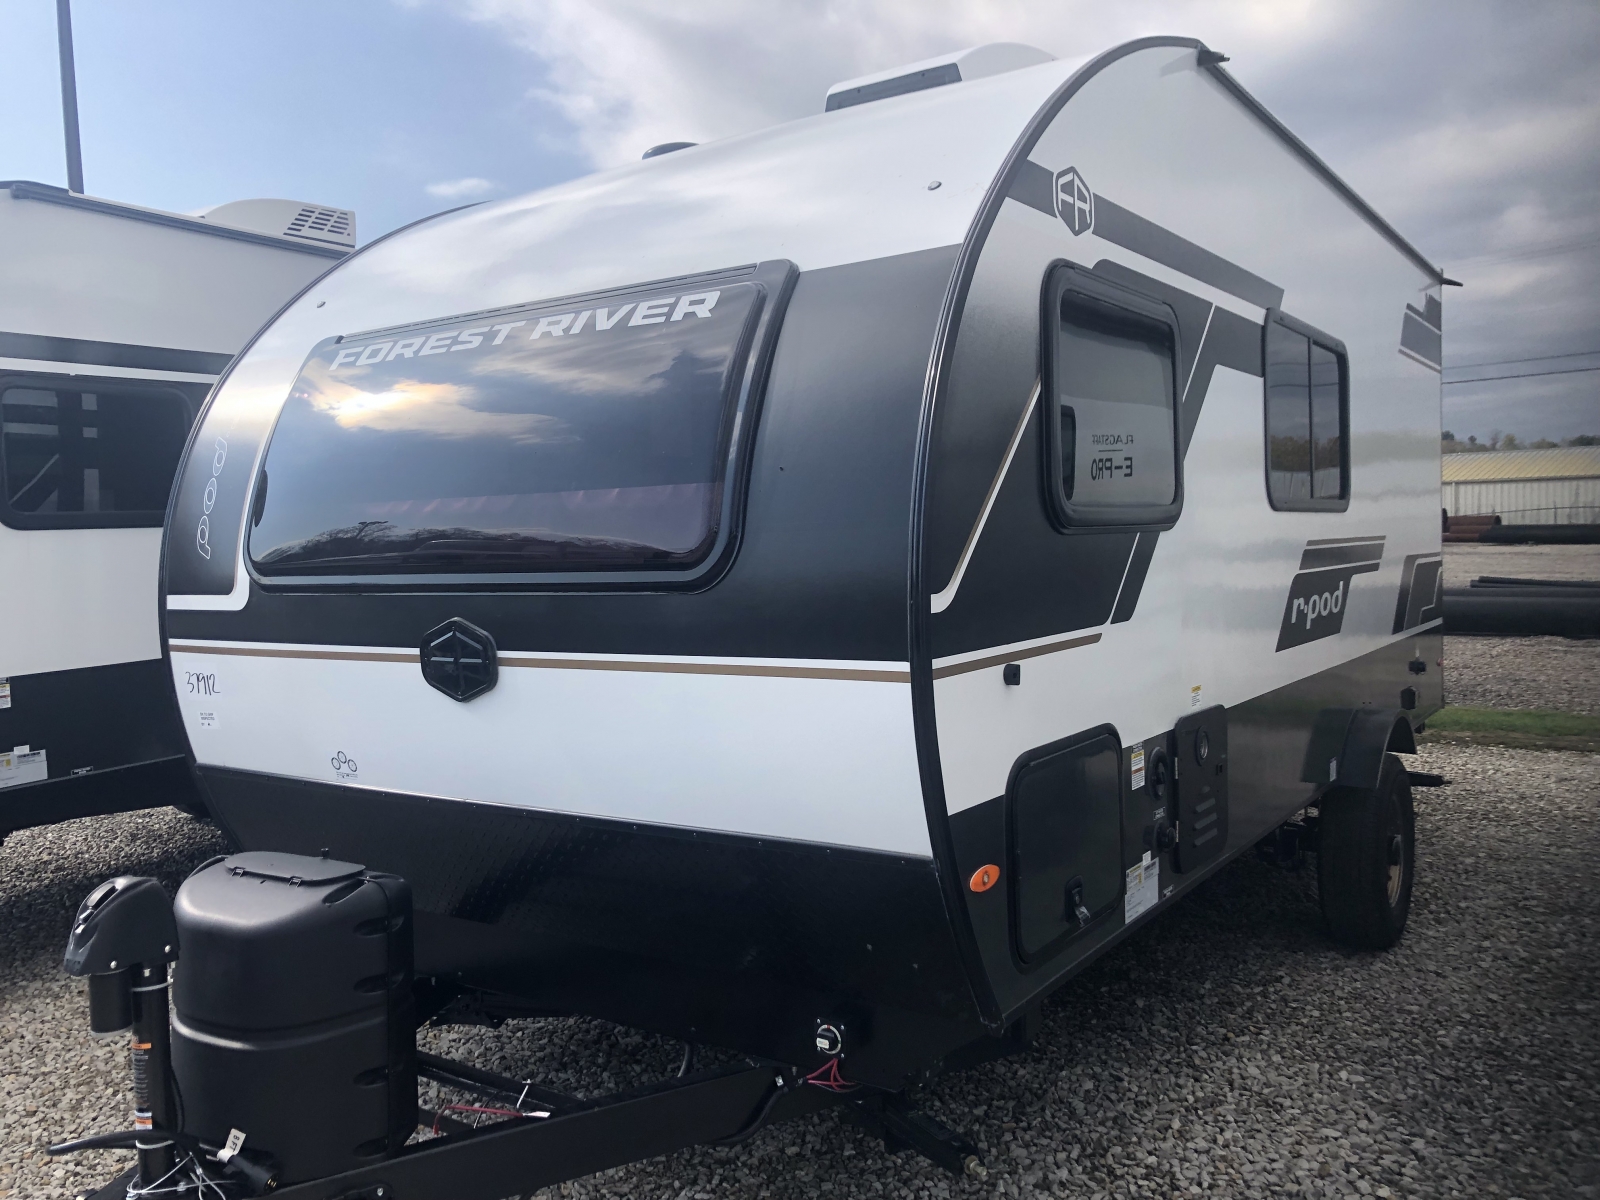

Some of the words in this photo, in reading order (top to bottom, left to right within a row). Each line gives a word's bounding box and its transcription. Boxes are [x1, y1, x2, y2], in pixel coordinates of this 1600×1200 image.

[328, 320, 526, 371] FOREST
[529, 290, 721, 340] RIVER
[184, 671, 221, 696] 37912
